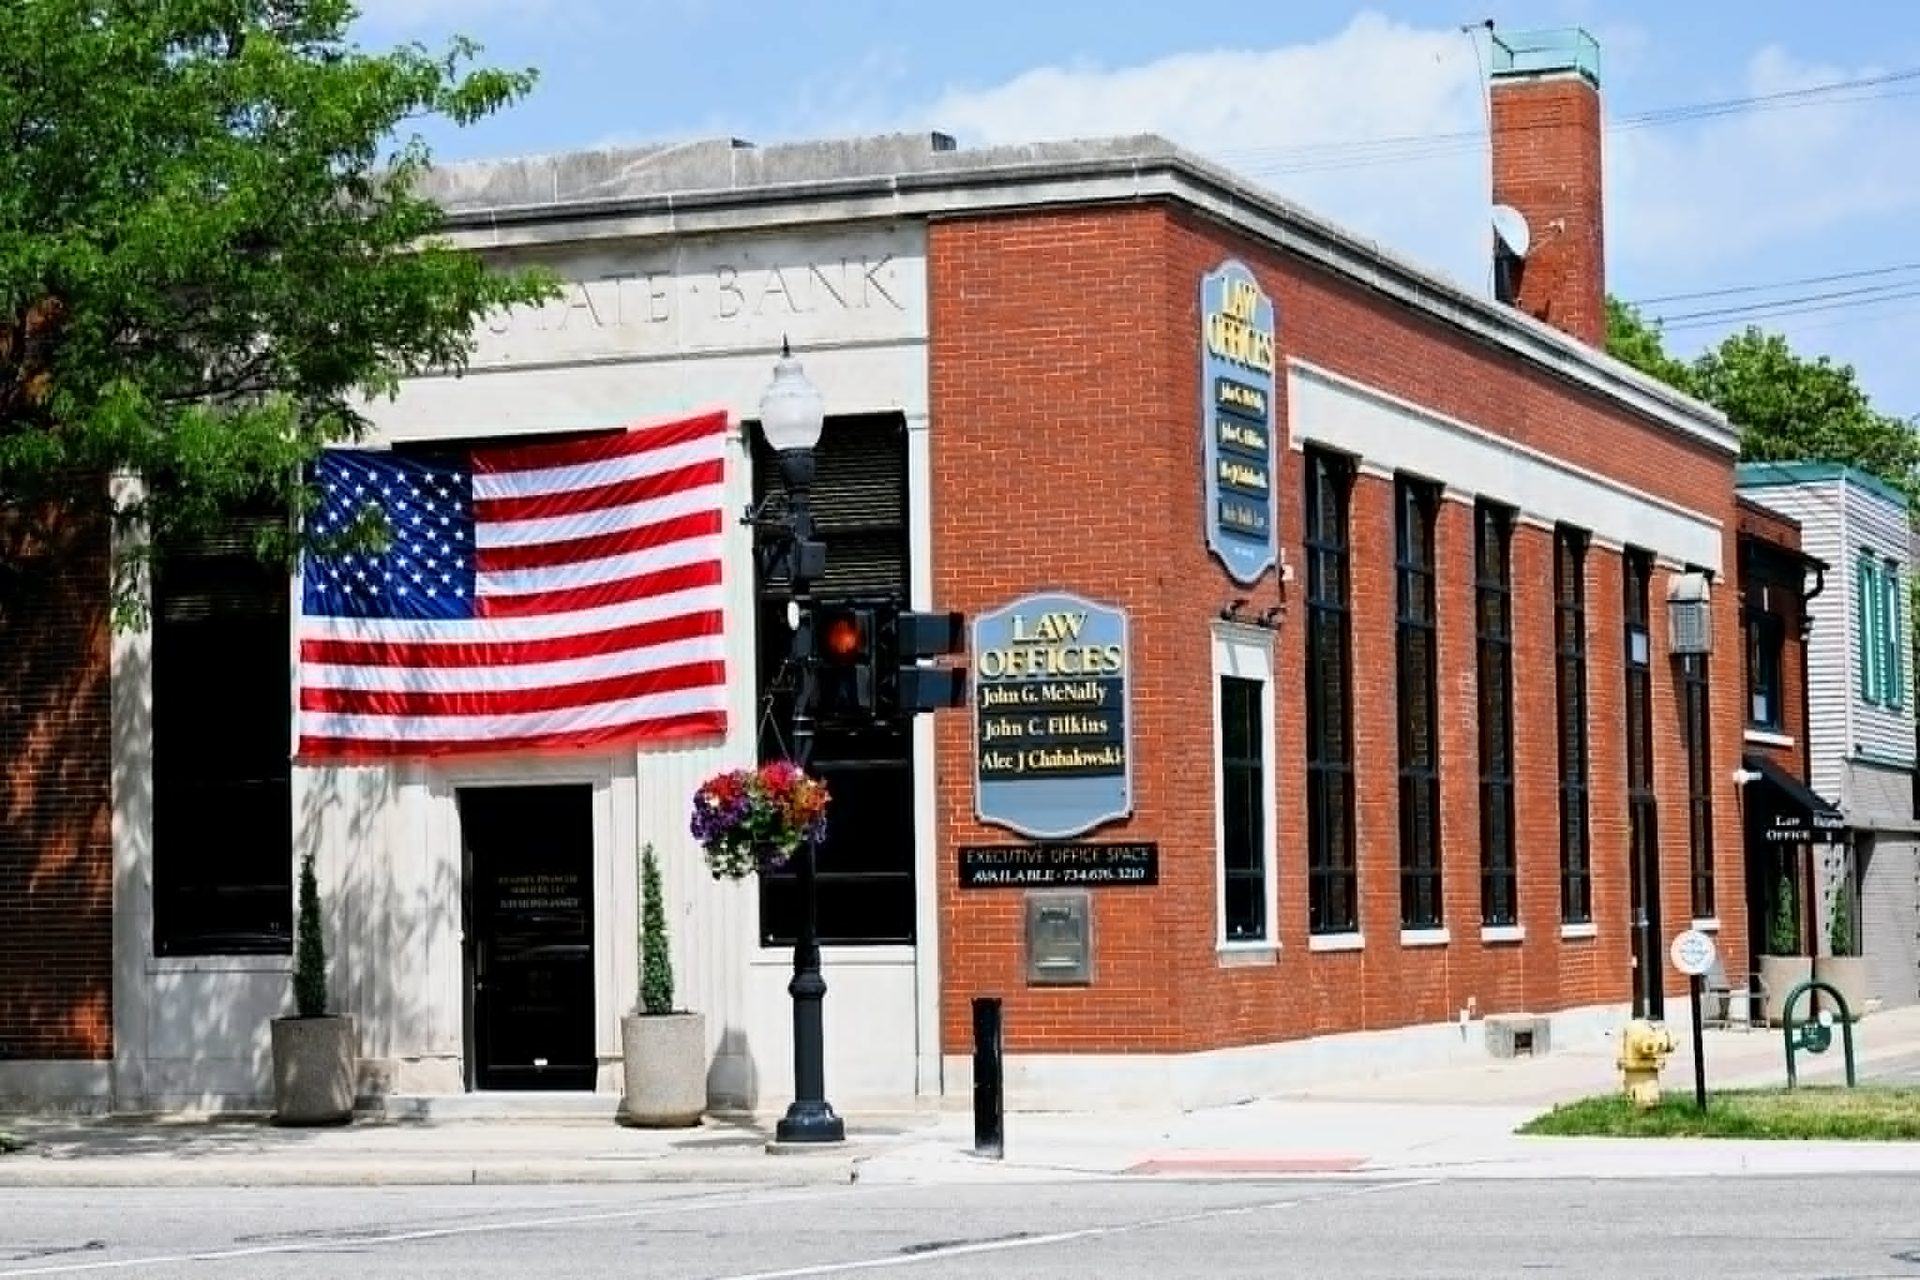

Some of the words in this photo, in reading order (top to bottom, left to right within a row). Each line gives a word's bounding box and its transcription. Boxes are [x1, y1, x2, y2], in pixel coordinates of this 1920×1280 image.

[488, 270, 671, 333] ATE
[714, 253, 906, 319] BANK
[1221, 275, 1257, 323] LAW
[1208, 313, 1273, 374] OFFICES
[1012, 610, 1088, 644] LAW
[979, 644, 1122, 678] OFFICES
[981, 683, 1021, 708] John
[1021, 683, 1039, 702] G.
[1041, 682, 1108, 705] McNally
[982, 717, 1023, 741] John
[1027, 718, 1044, 736] C.
[1048, 714, 1109, 735] Filkins
[981, 751, 1014, 770] Alec
[966, 848, 1044, 864] EXECUTIVE
[1050, 847, 1101, 863] OFFICE
[1106, 846, 1149, 863] SPACE
[972, 869, 1055, 884] AVAILABLE
